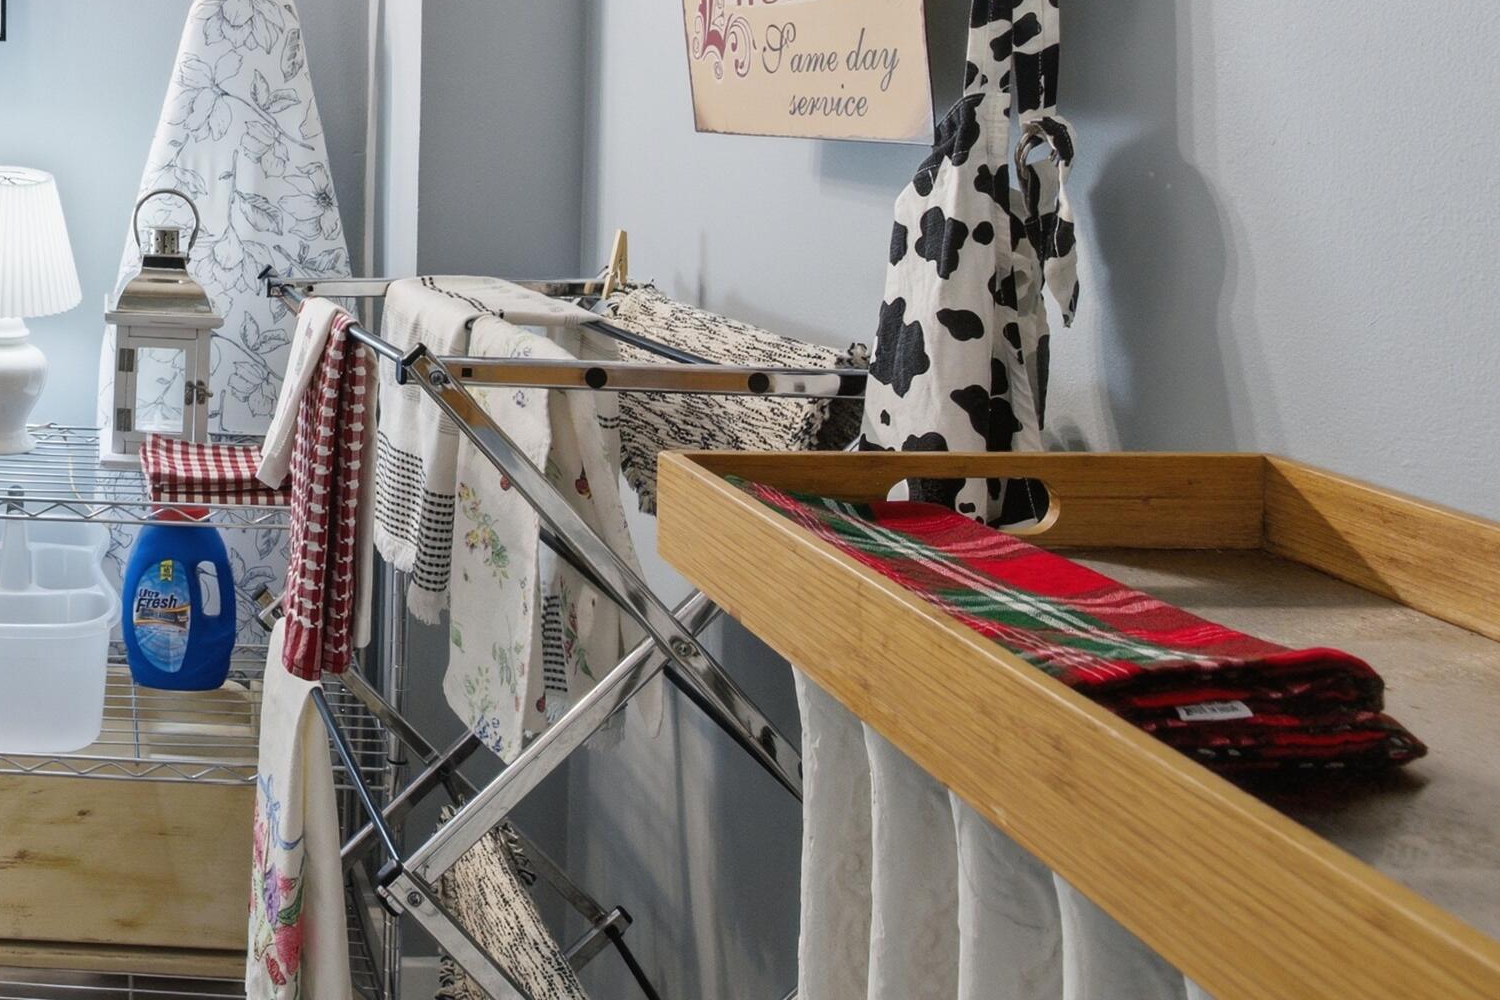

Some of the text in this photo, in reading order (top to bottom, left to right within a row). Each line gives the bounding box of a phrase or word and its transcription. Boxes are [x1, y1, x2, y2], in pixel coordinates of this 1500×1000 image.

[761, 22, 901, 92] Same day
[789, 83, 869, 117] service
[135, 594, 178, 613] Fresh
